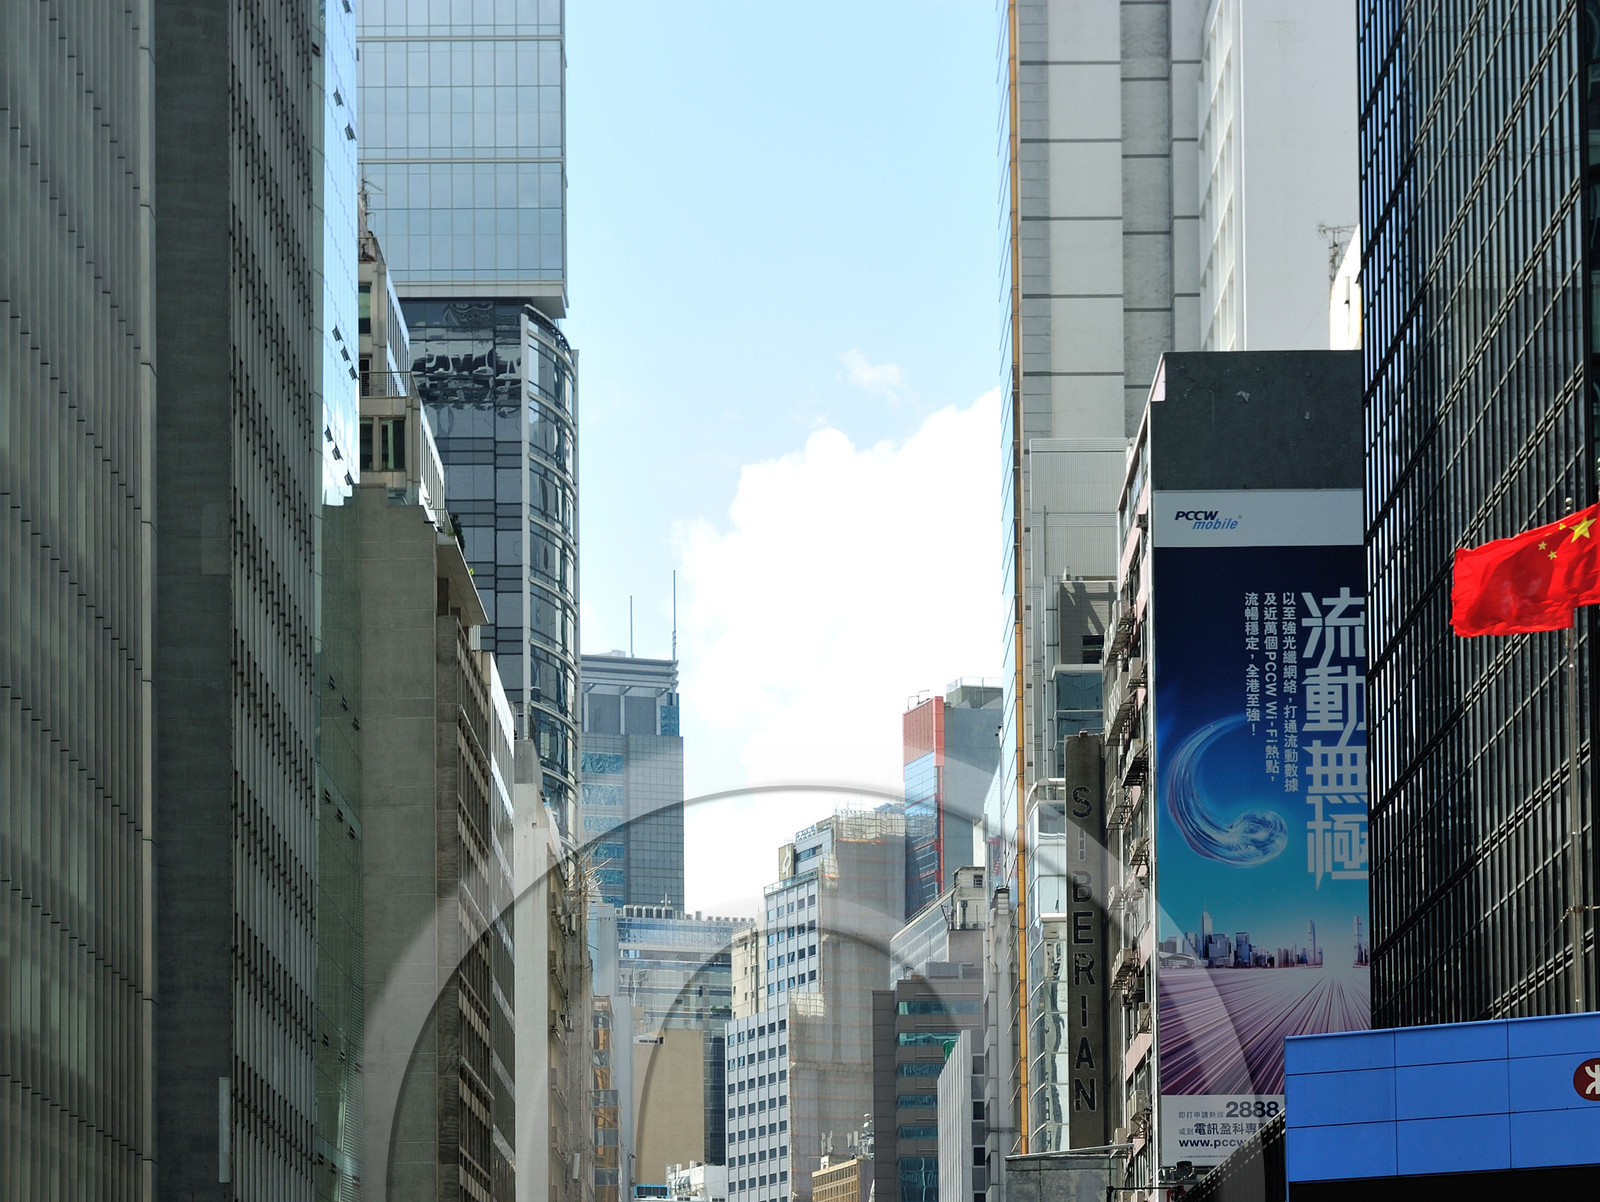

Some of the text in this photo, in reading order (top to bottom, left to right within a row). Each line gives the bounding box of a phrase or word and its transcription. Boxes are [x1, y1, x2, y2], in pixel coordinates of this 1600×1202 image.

[1174, 510, 1219, 521] PCCW
[1192, 518, 1239, 530] mobile
[1301, 586, 1369, 891] 流動無極
[1070, 785, 1099, 1112] SIBERIAN
